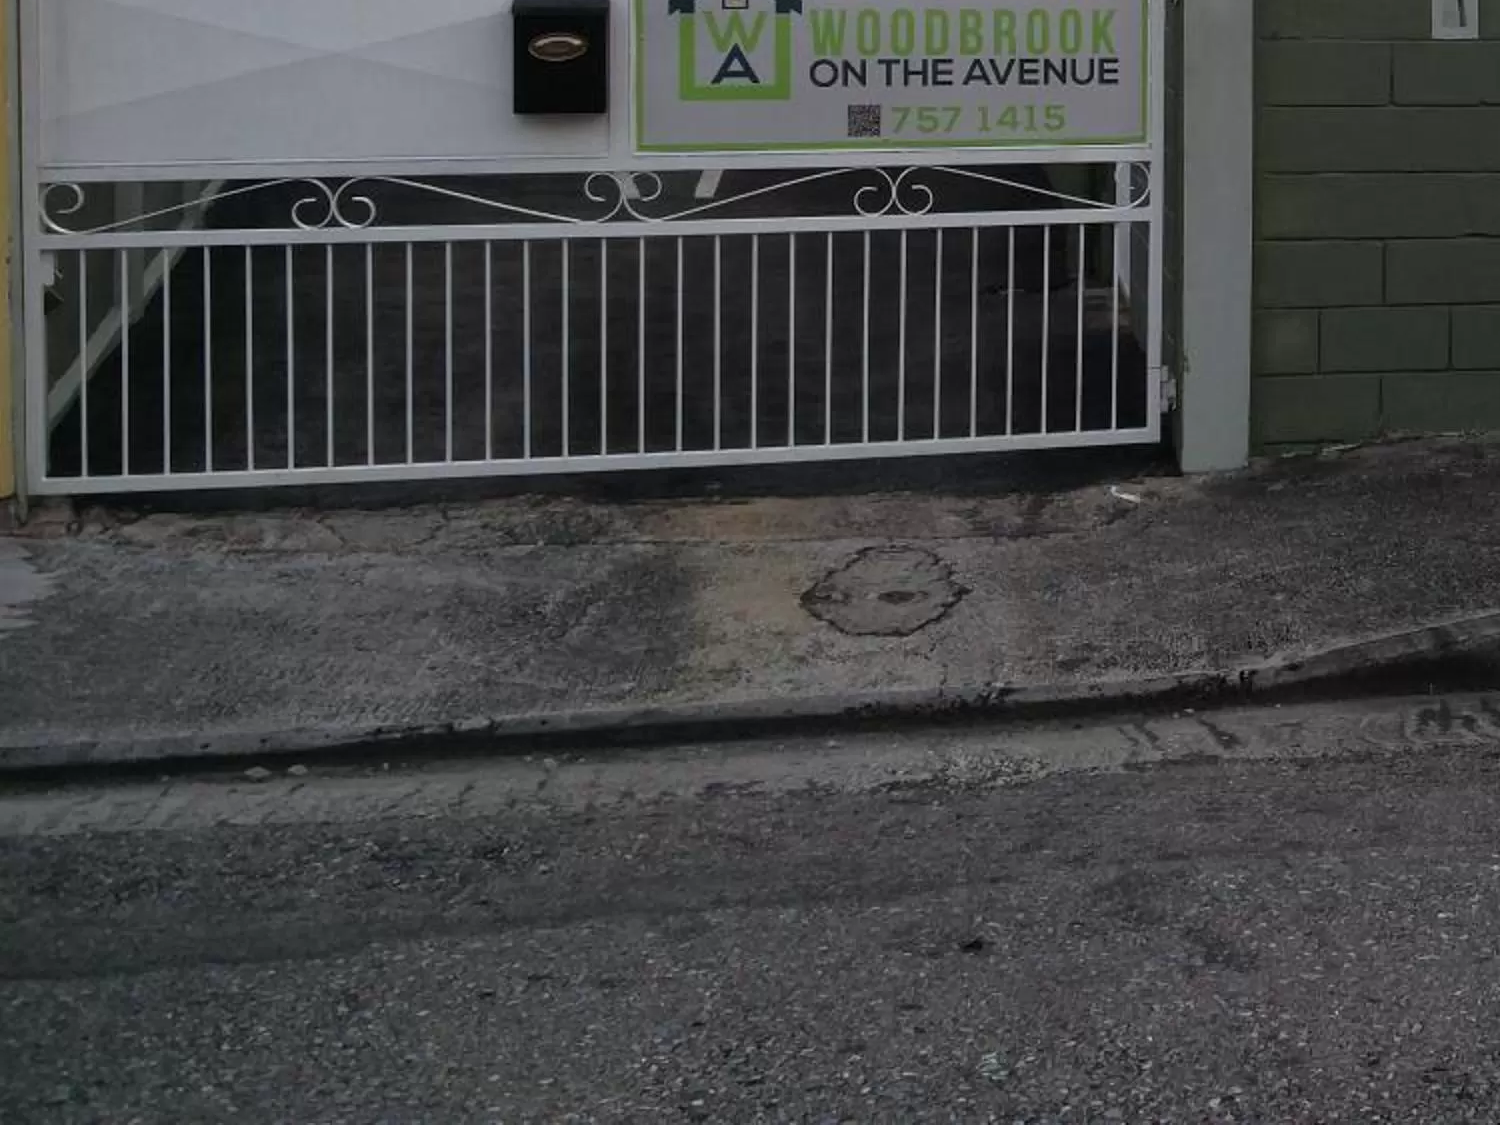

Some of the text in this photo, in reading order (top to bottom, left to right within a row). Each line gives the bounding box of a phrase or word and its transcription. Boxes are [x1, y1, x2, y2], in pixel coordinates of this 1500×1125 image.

[703, 10, 768, 53] W
[809, 8, 1118, 56] WOODBROOK
[710, 42, 761, 84] A
[809, 58, 1119, 88] ON THE AVENUE
[890, 104, 1067, 134] 757 1415
